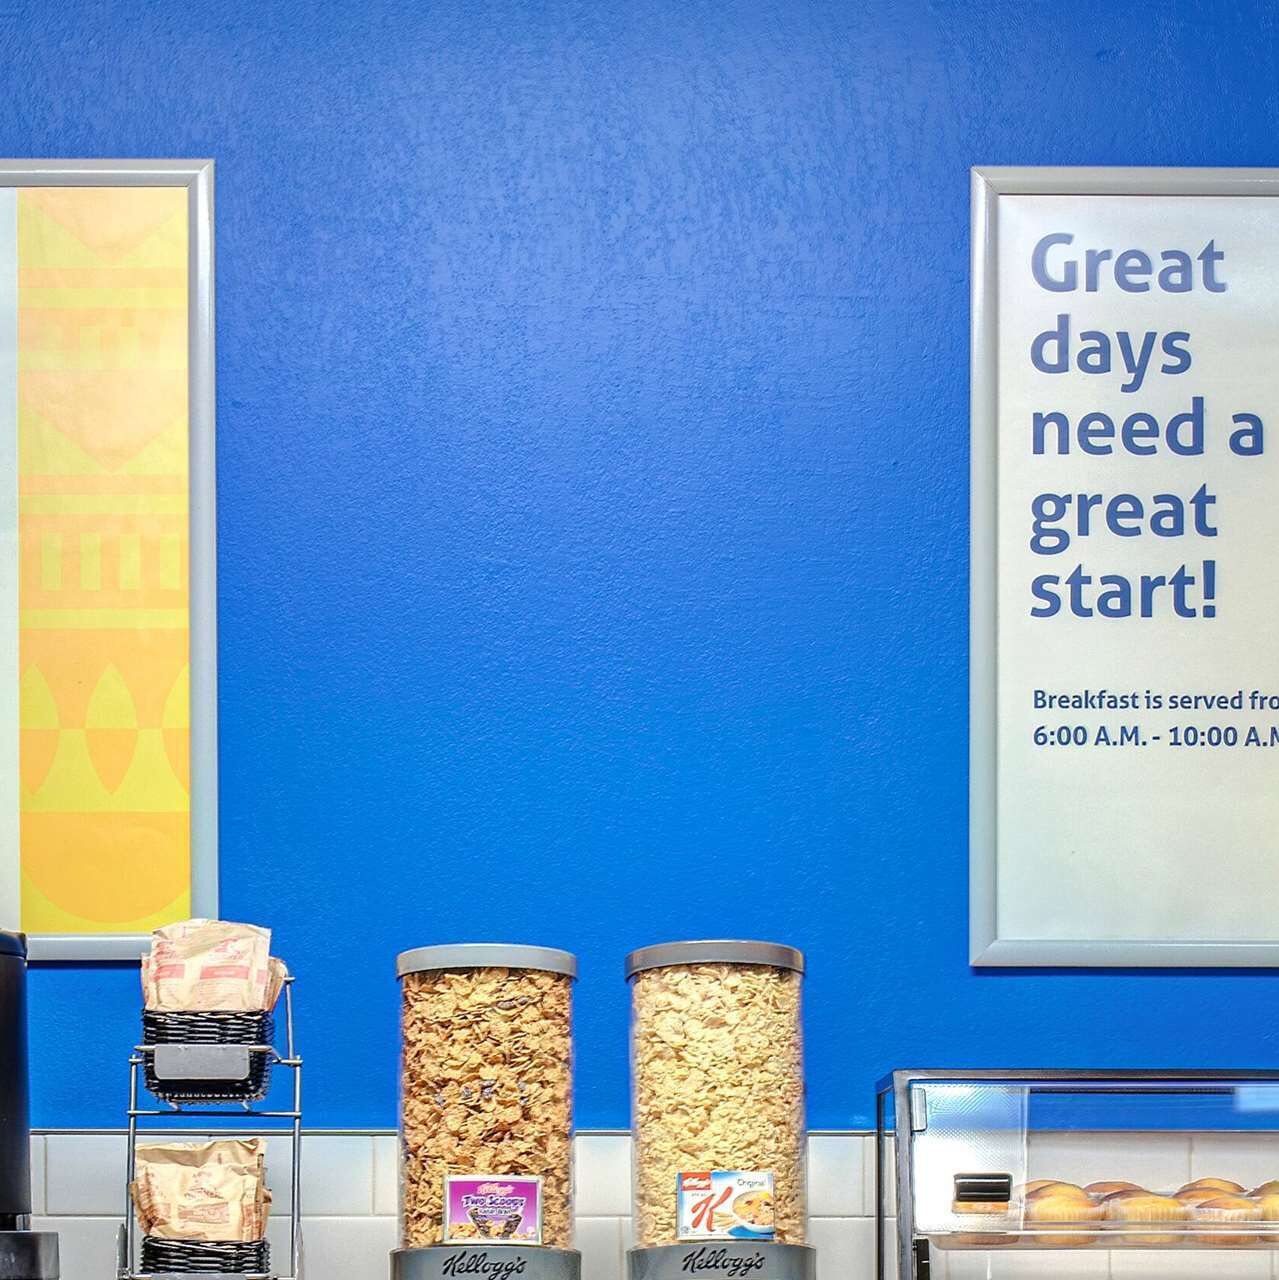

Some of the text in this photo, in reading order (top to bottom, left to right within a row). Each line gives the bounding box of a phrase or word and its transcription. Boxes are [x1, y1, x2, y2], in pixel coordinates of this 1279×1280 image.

[1031, 233, 1227, 294] Great
[1030, 314, 1192, 393] days
[1032, 397, 1265, 457] need a
[1030, 483, 1218, 556] great
[1030, 560, 1216, 619] start!
[1033, 689, 1140, 710] Breakfast
[1145, 690, 1163, 710] is
[1169, 690, 1243, 710] served
[1033, 725, 1088, 746] 6:00
[1094, 725, 1147, 747] A.M.
[1169, 726, 1238, 747] 10:00
[442, 1250, 528, 1280] Kellogg's
[682, 1246, 765, 1277] Kellogg's
